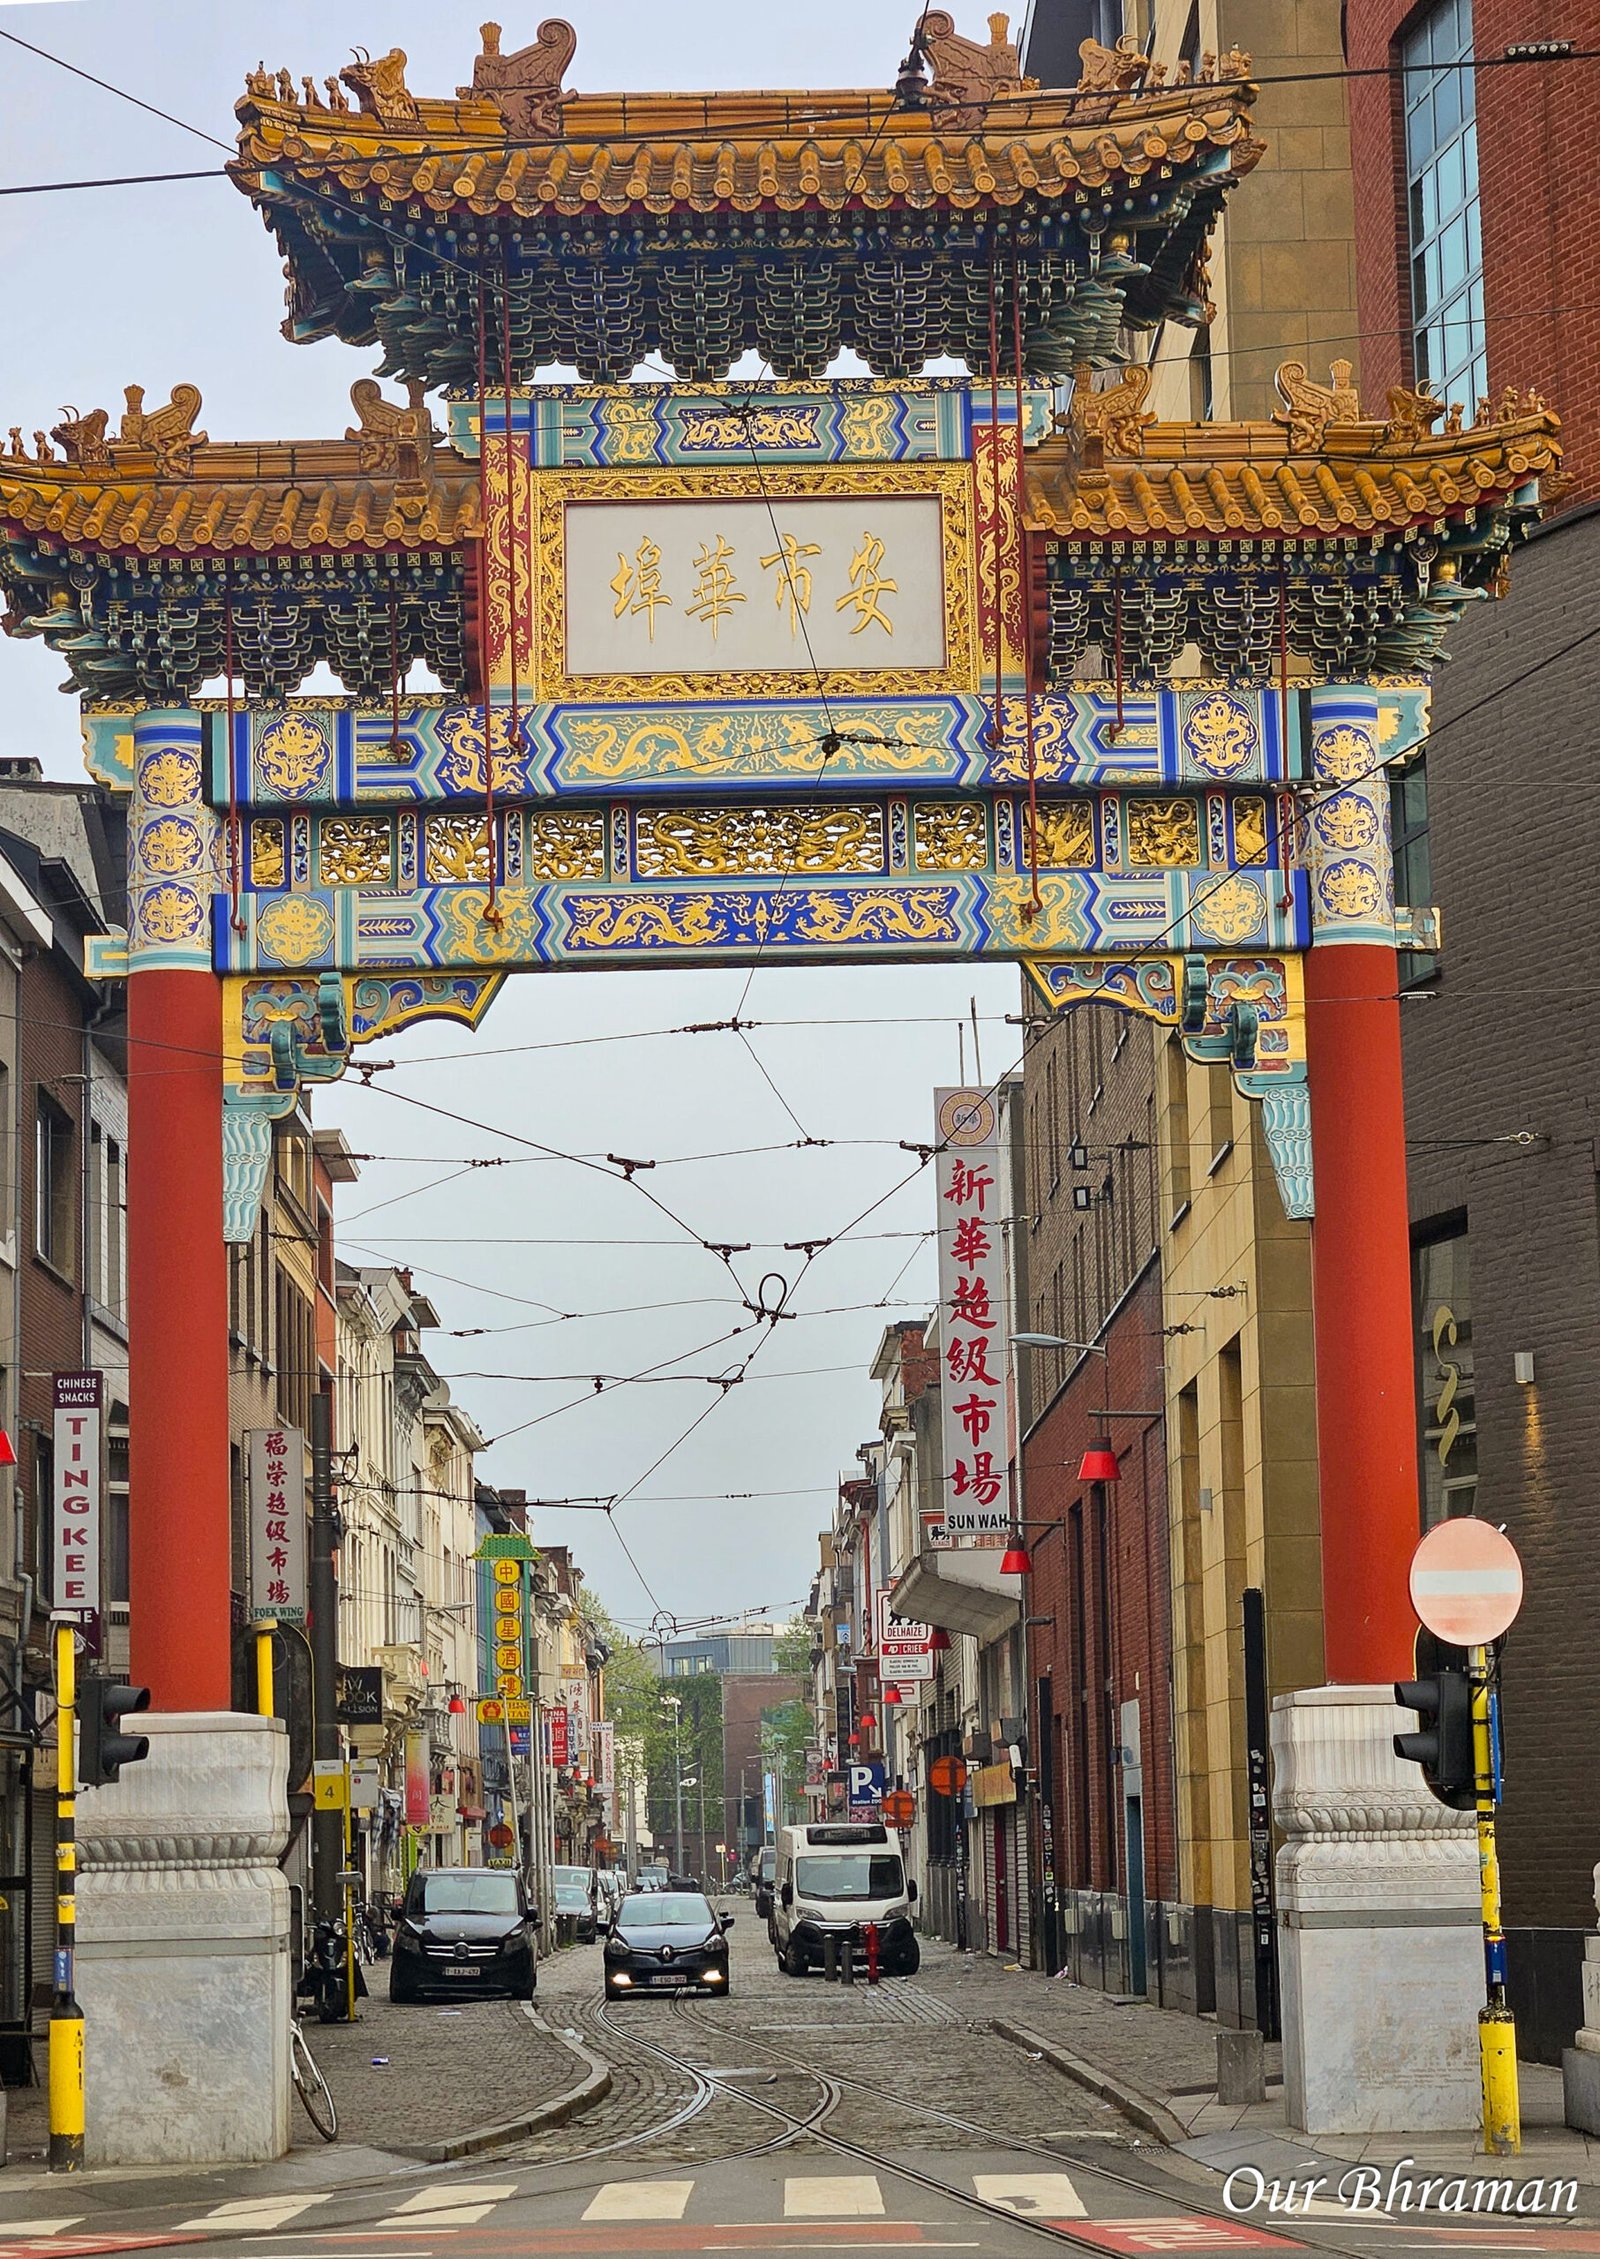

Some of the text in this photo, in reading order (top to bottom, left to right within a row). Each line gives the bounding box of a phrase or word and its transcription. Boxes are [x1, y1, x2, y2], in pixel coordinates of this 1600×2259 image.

[942, 1157, 1002, 1507] 新華超級市場
[57, 1377, 97, 1390] CHINESE
[58, 1391, 96, 1404] SNACKS
[948, 1513, 1008, 1529] SUN WAH
[254, 1606, 304, 1618] FOEK WING
[887, 1626, 923, 1638] DELHAIZE
[902, 1644, 924, 1654] CRIEE
[850, 1766, 873, 1795] P
[324, 1785, 335, 1799] 4
[491, 1858, 510, 1866] TAXI
